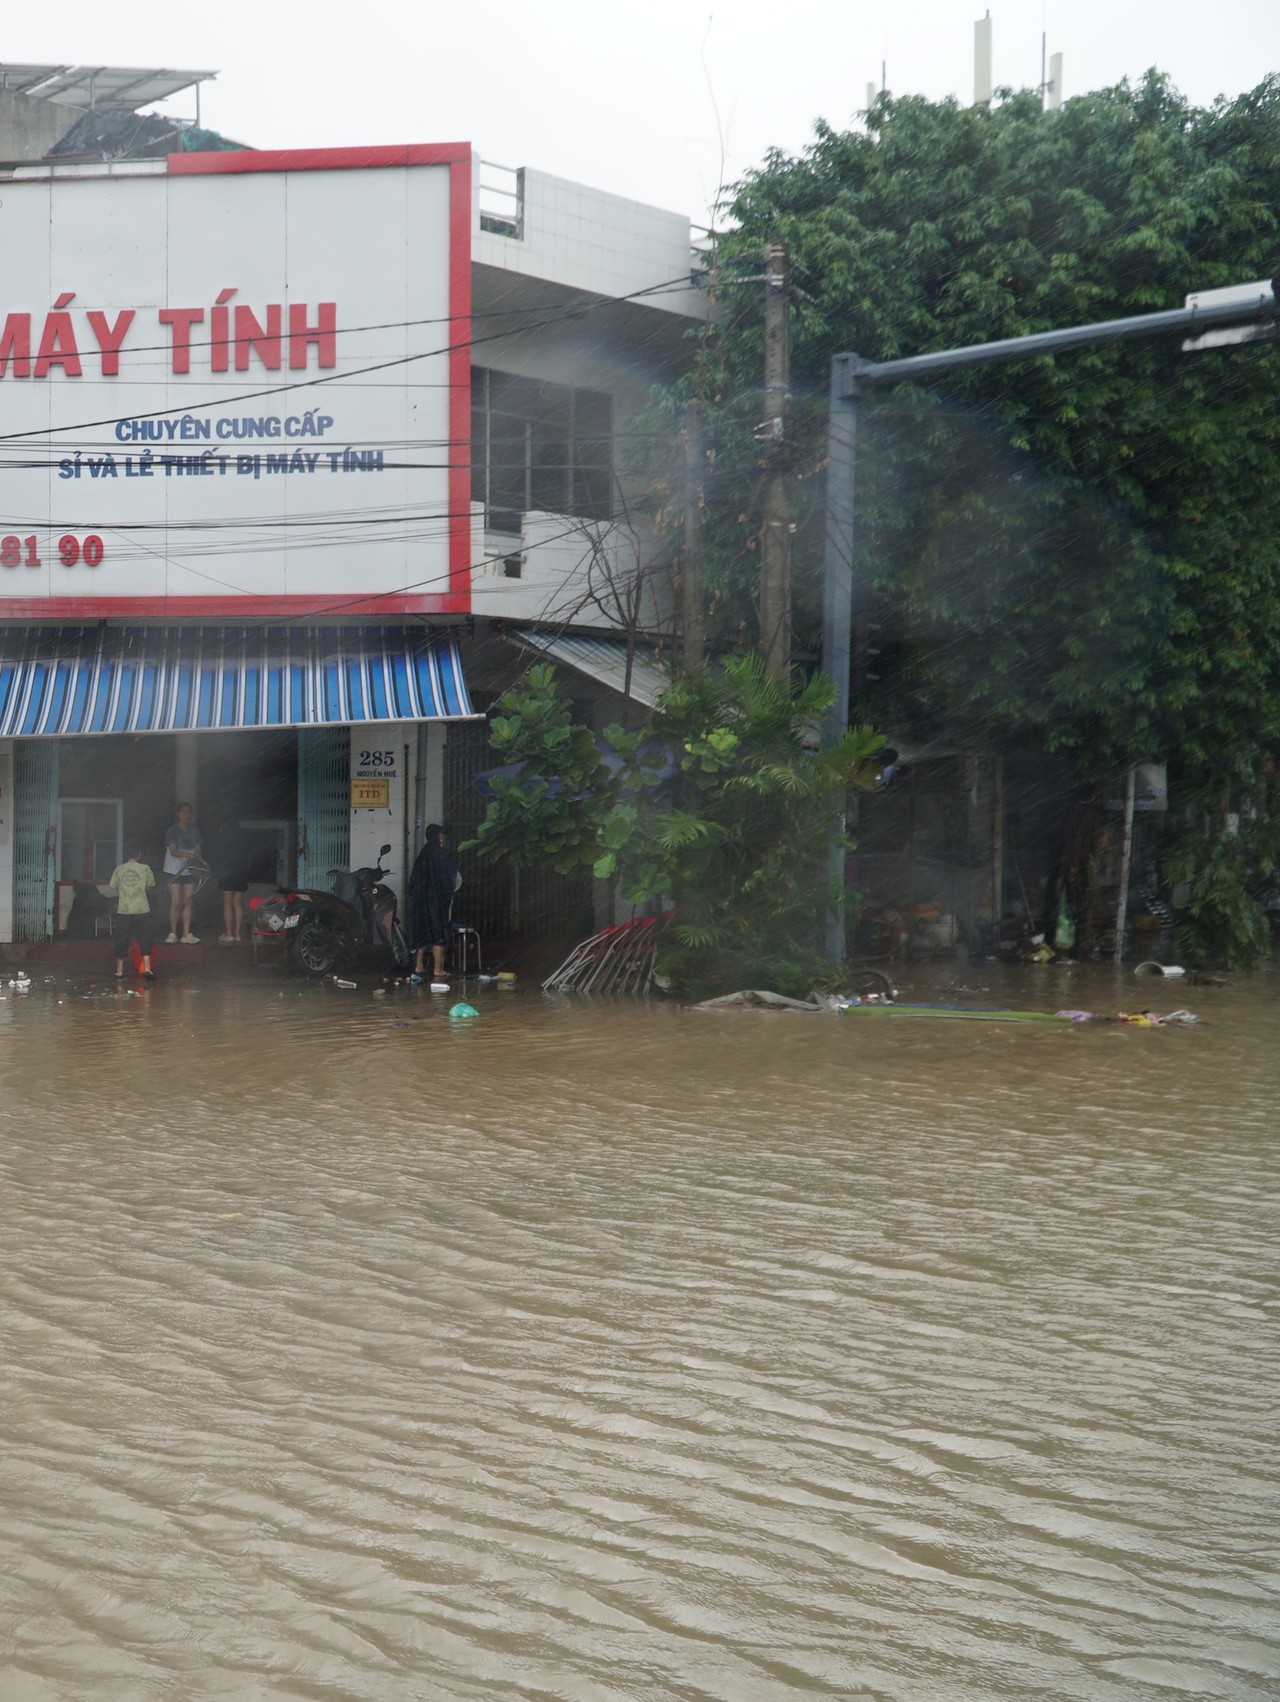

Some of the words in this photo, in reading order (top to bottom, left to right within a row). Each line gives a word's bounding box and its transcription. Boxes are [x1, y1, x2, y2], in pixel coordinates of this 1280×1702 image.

[159, 288, 337, 374] TÍNH
[115, 414, 211, 442] CHUYÊN
[216, 417, 281, 439] CUNG
[284, 408, 334, 437] CẤP
[58, 450, 81, 479] SỈ
[87, 452, 118, 478] VÀ
[125, 449, 154, 477] LẺ
[164, 447, 231, 476] THIẾT
[237, 454, 261, 479] BỊ
[266, 448, 320, 474] MÁY
[326, 447, 384, 473] TÍNH
[0, 535, 41, 567] 81
[58, 534, 104, 567] 90
[359, 750, 395, 767] 285
[359, 790, 381, 799] ITD
